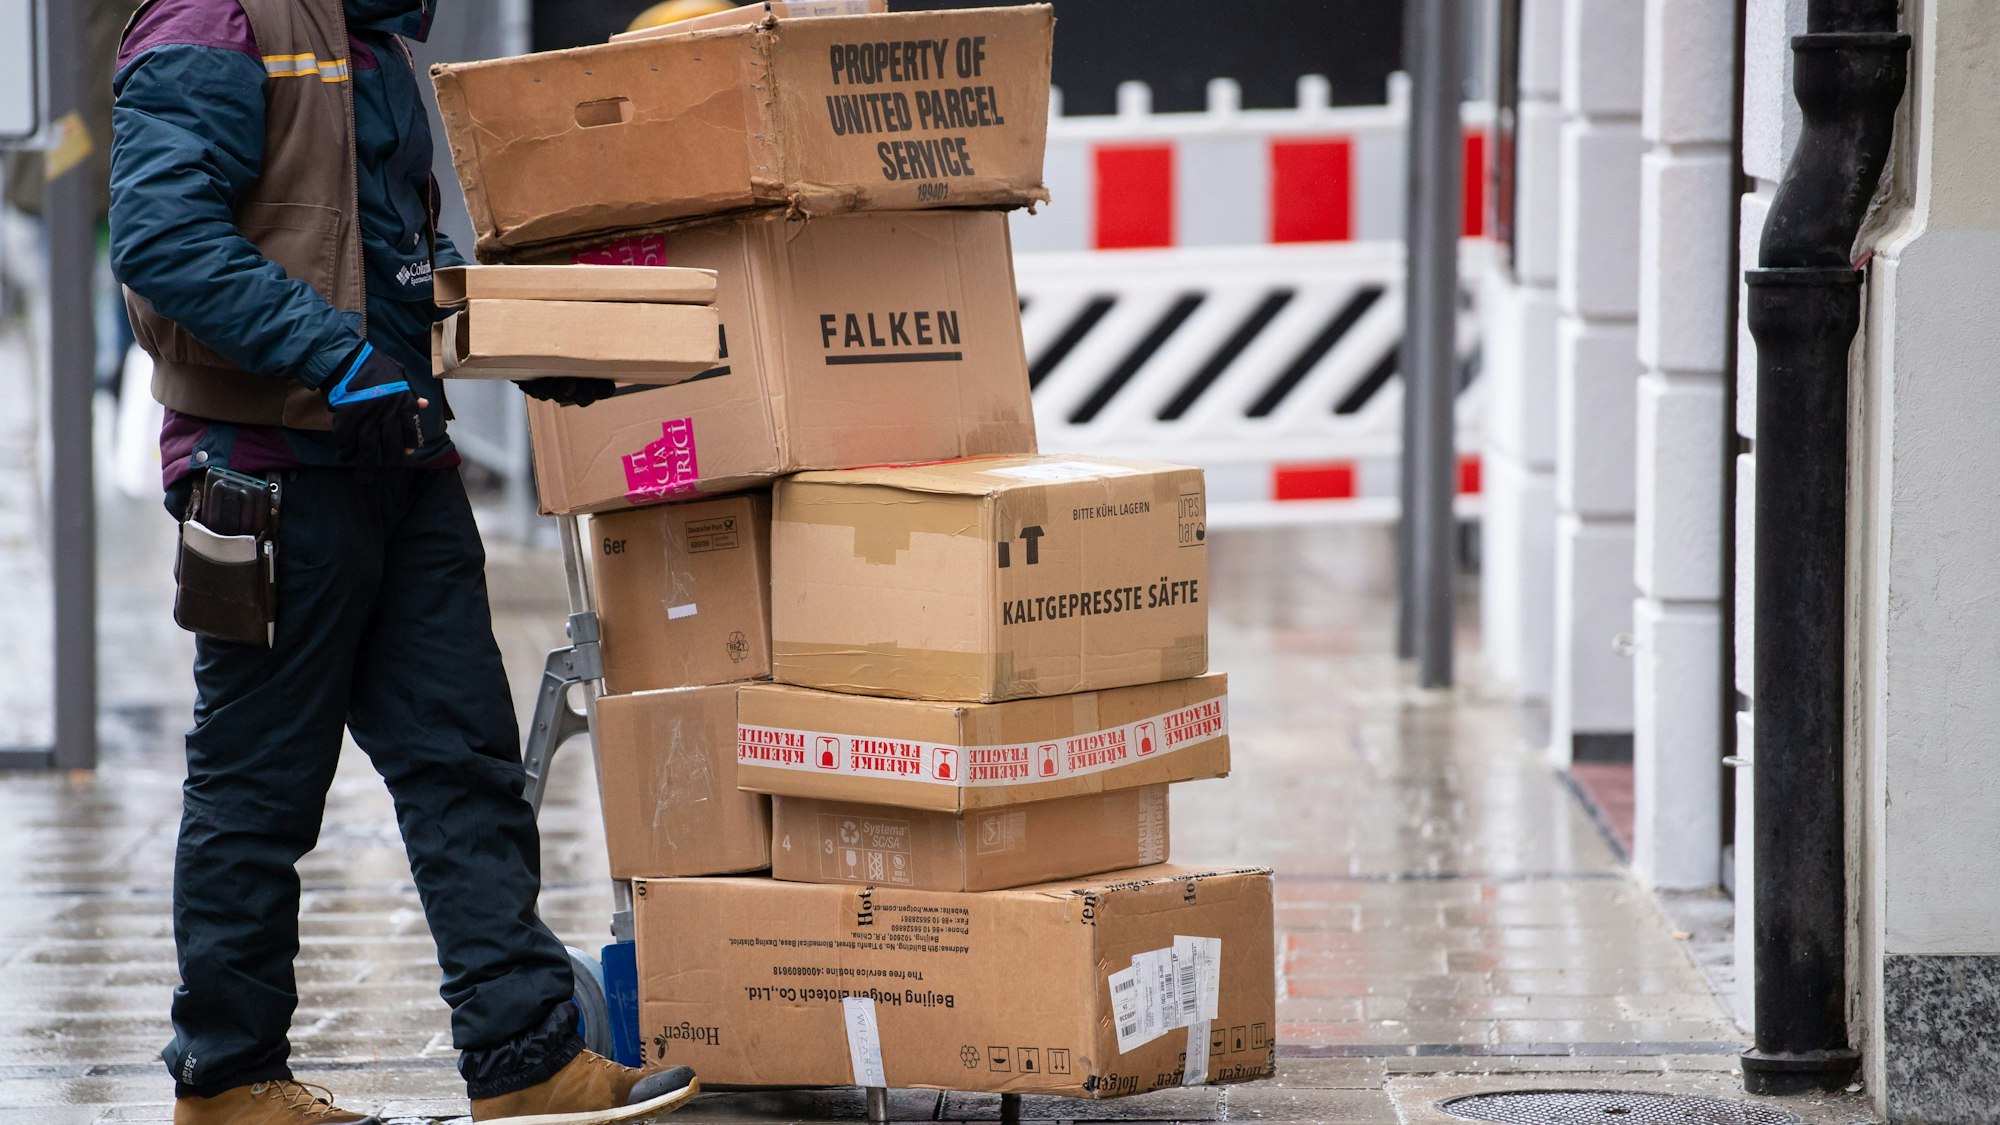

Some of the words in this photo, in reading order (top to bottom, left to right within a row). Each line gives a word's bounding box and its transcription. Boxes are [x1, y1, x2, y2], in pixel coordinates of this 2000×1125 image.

[830, 39, 949, 85] PROPERTY
[956, 36, 986, 79] OF
[825, 92, 913, 136] UNITED
[915, 86, 1005, 130] PARCEL
[877, 137, 975, 181] SERVICE
[819, 310, 961, 348] FALKEN
[1073, 507, 1094, 521] BITTE
[1096, 503, 1118, 518] KÜHL
[1119, 501, 1150, 516] LAGERN
[603, 537, 627, 555] 6er
[1003, 586, 1142, 626] KALTGEPRESSTE
[1148, 576, 1198, 609] SÄFTE
[1163, 700, 1221, 730] FRAGILE
[739, 727, 805, 748] FRAGILE
[1067, 728, 1126, 754] FRAGILE
[1164, 717, 1222, 748] KŘEHKÉ
[738, 744, 805, 766] KŘEHKÉ
[851, 739, 921, 759] FRAGILE
[969, 747, 1029, 763] FRAGILE
[851, 755, 921, 776] KŘEHKÉ
[1067, 745, 1127, 772] KŘEHKÉ
[969, 763, 1029, 783] KŘEHKÉ
[782, 834, 792, 852] 4
[825, 839, 834, 854] 3
[872, 835, 900, 849] SC/SA
[932, 916, 940, 924] 10
[940, 907, 969, 916] Website:
[941, 916, 953, 924] +86
[954, 916, 969, 925] Fax:
[850, 932, 873, 940] China.
[873, 932, 886, 940] P.R.
[914, 934, 939, 943] Beijing,
[945, 925, 969, 935] Phone:
[755, 938, 778, 947] Daxing
[778, 939, 797, 948] Base,
[797, 940, 833, 949] Biomedical
[857, 942, 878, 950] Tianfu
[826, 967, 855, 978] hotline
[856, 969, 888, 979] service
[889, 970, 906, 980] free
[907, 970, 924, 981] The
[744, 986, 796, 1002] Co.,Ltd.
[853, 988, 901, 1006] Hotgen
[905, 989, 955, 1008] Beijing
[663, 1021, 720, 1046] Hotgen
